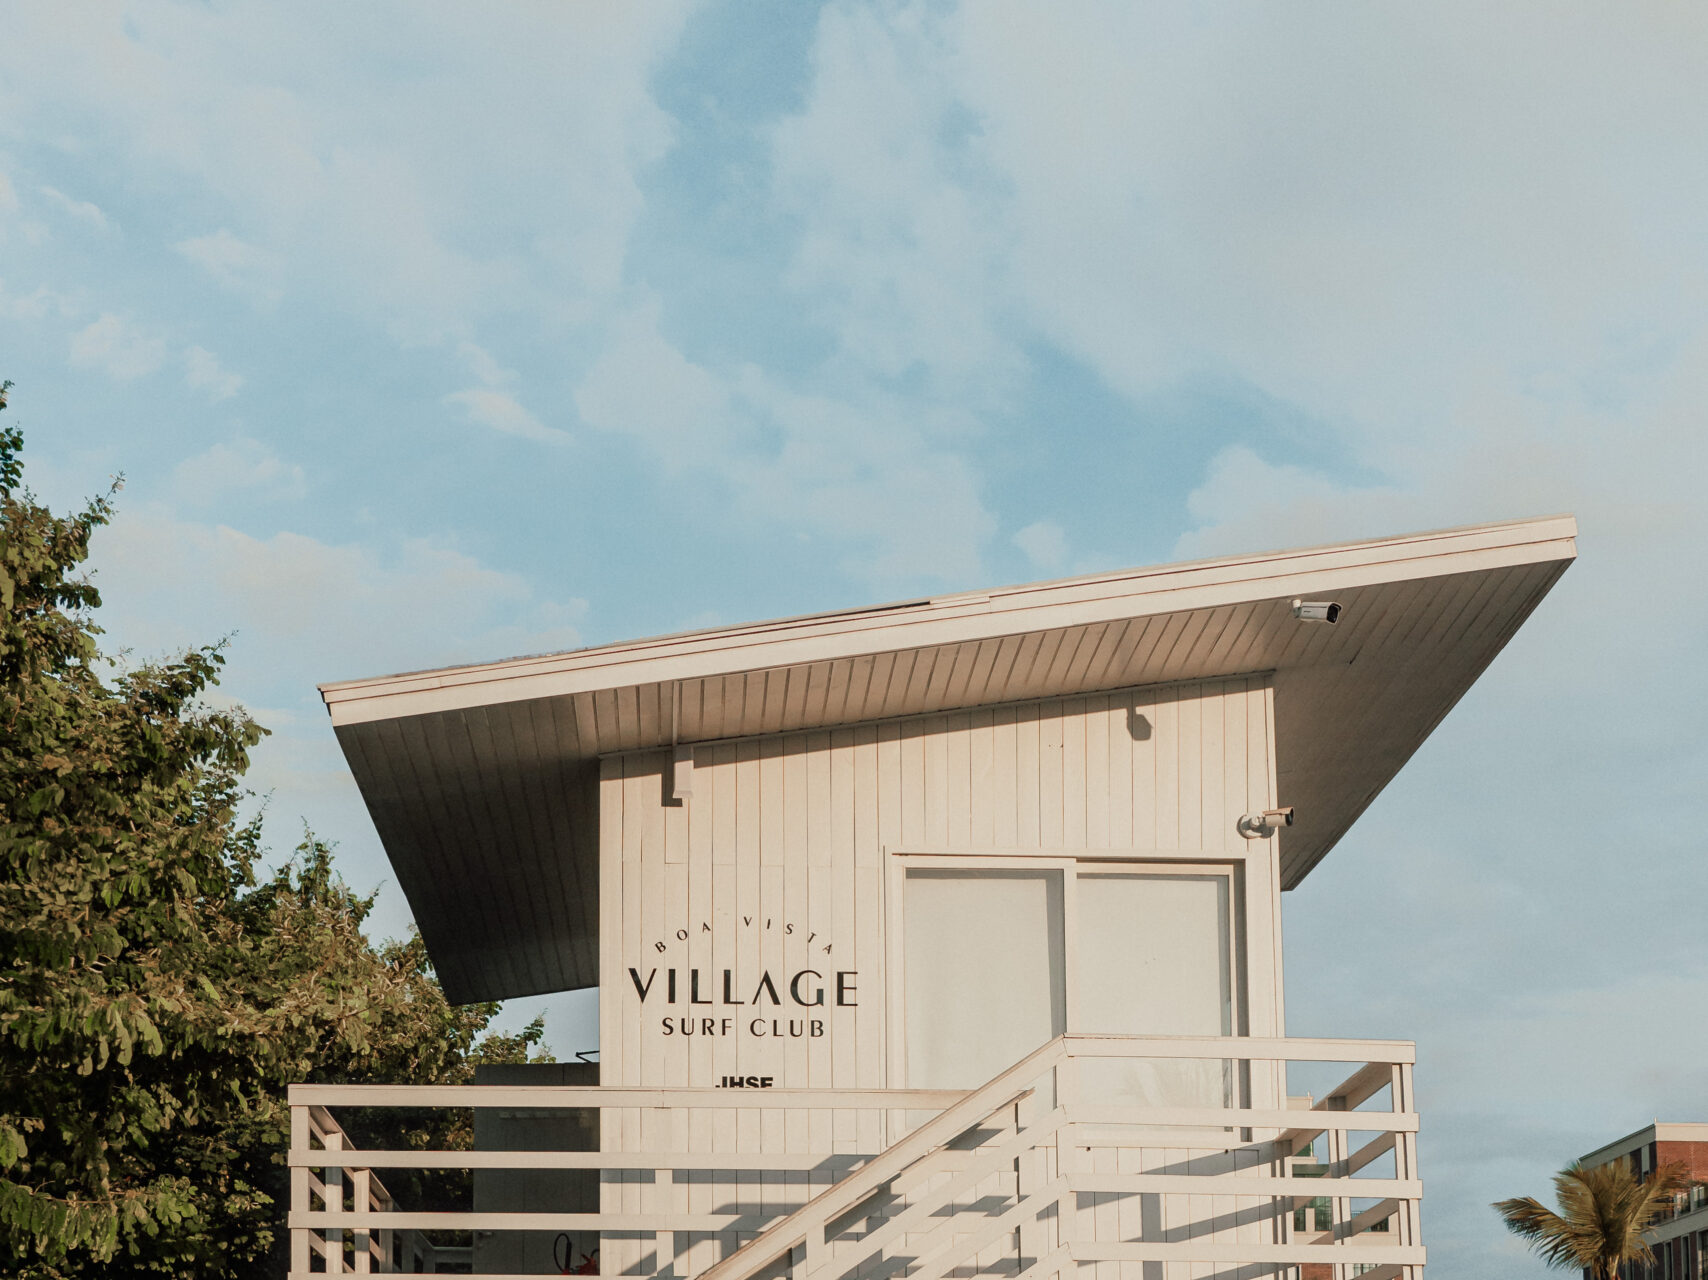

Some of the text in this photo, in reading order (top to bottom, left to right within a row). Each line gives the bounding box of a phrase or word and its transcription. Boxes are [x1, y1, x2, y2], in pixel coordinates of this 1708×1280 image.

[655, 916, 832, 954] BOA VISTA
[628, 967, 858, 1007] VILLAGE
[662, 1017, 824, 1037] SURF CLUB
